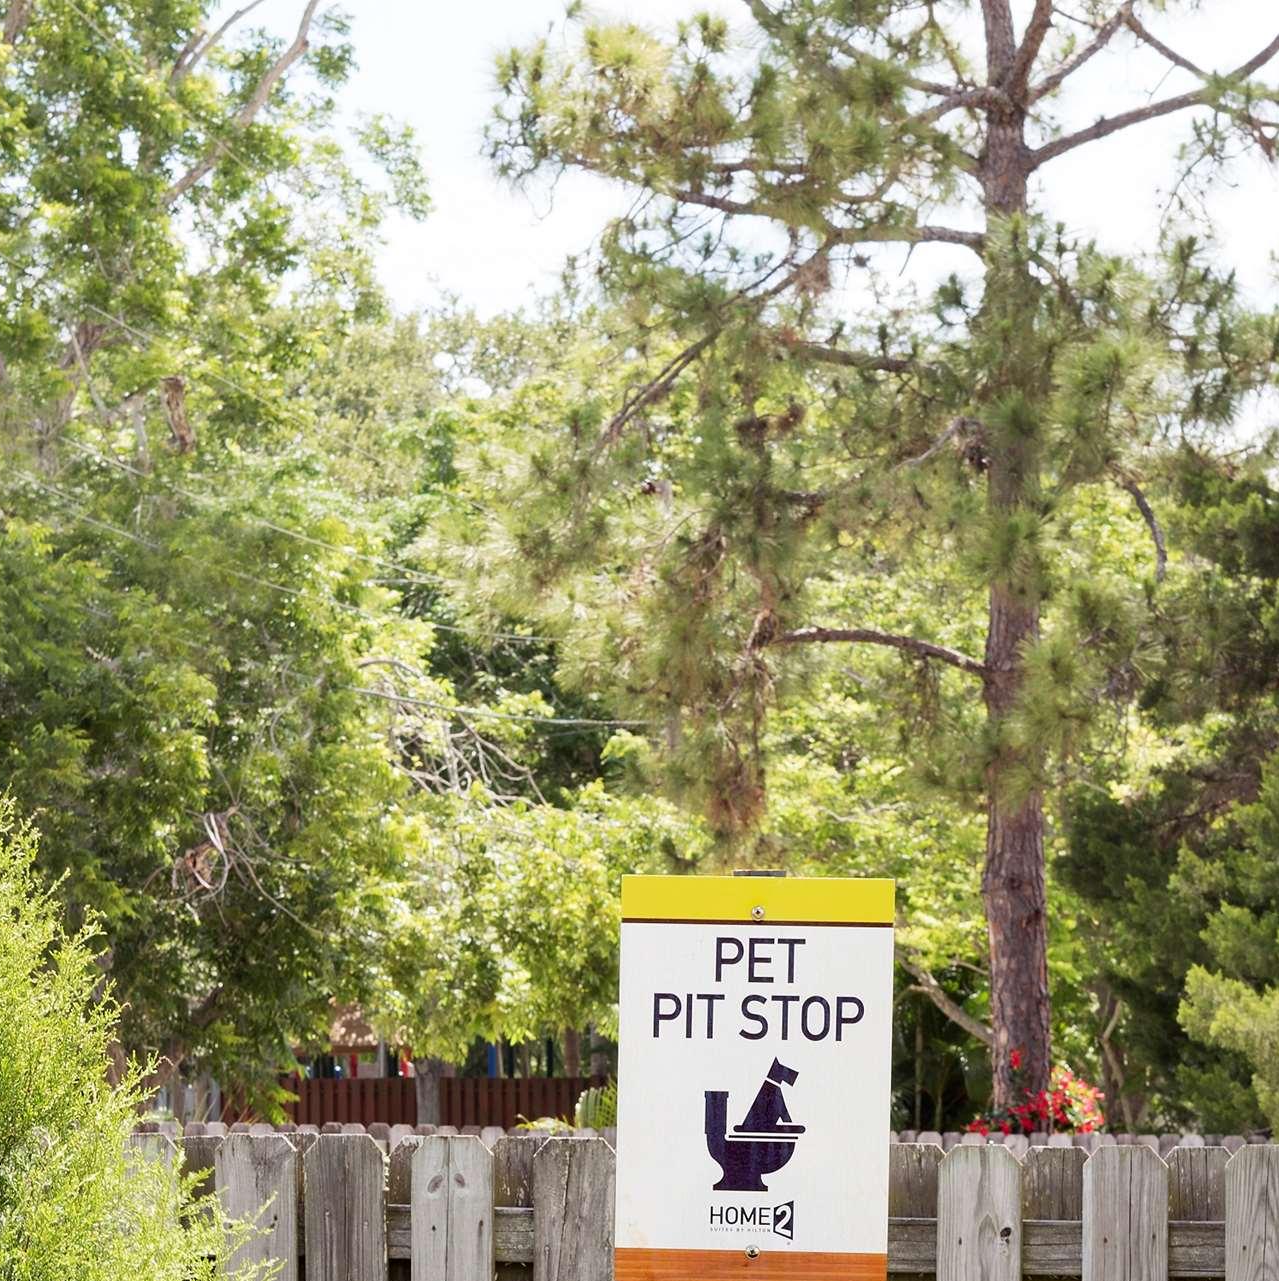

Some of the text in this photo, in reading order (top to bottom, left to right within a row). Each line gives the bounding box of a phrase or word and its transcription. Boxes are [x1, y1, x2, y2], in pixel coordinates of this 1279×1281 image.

[715, 937, 806, 983] PET
[653, 993, 865, 1041] PIT STOP
